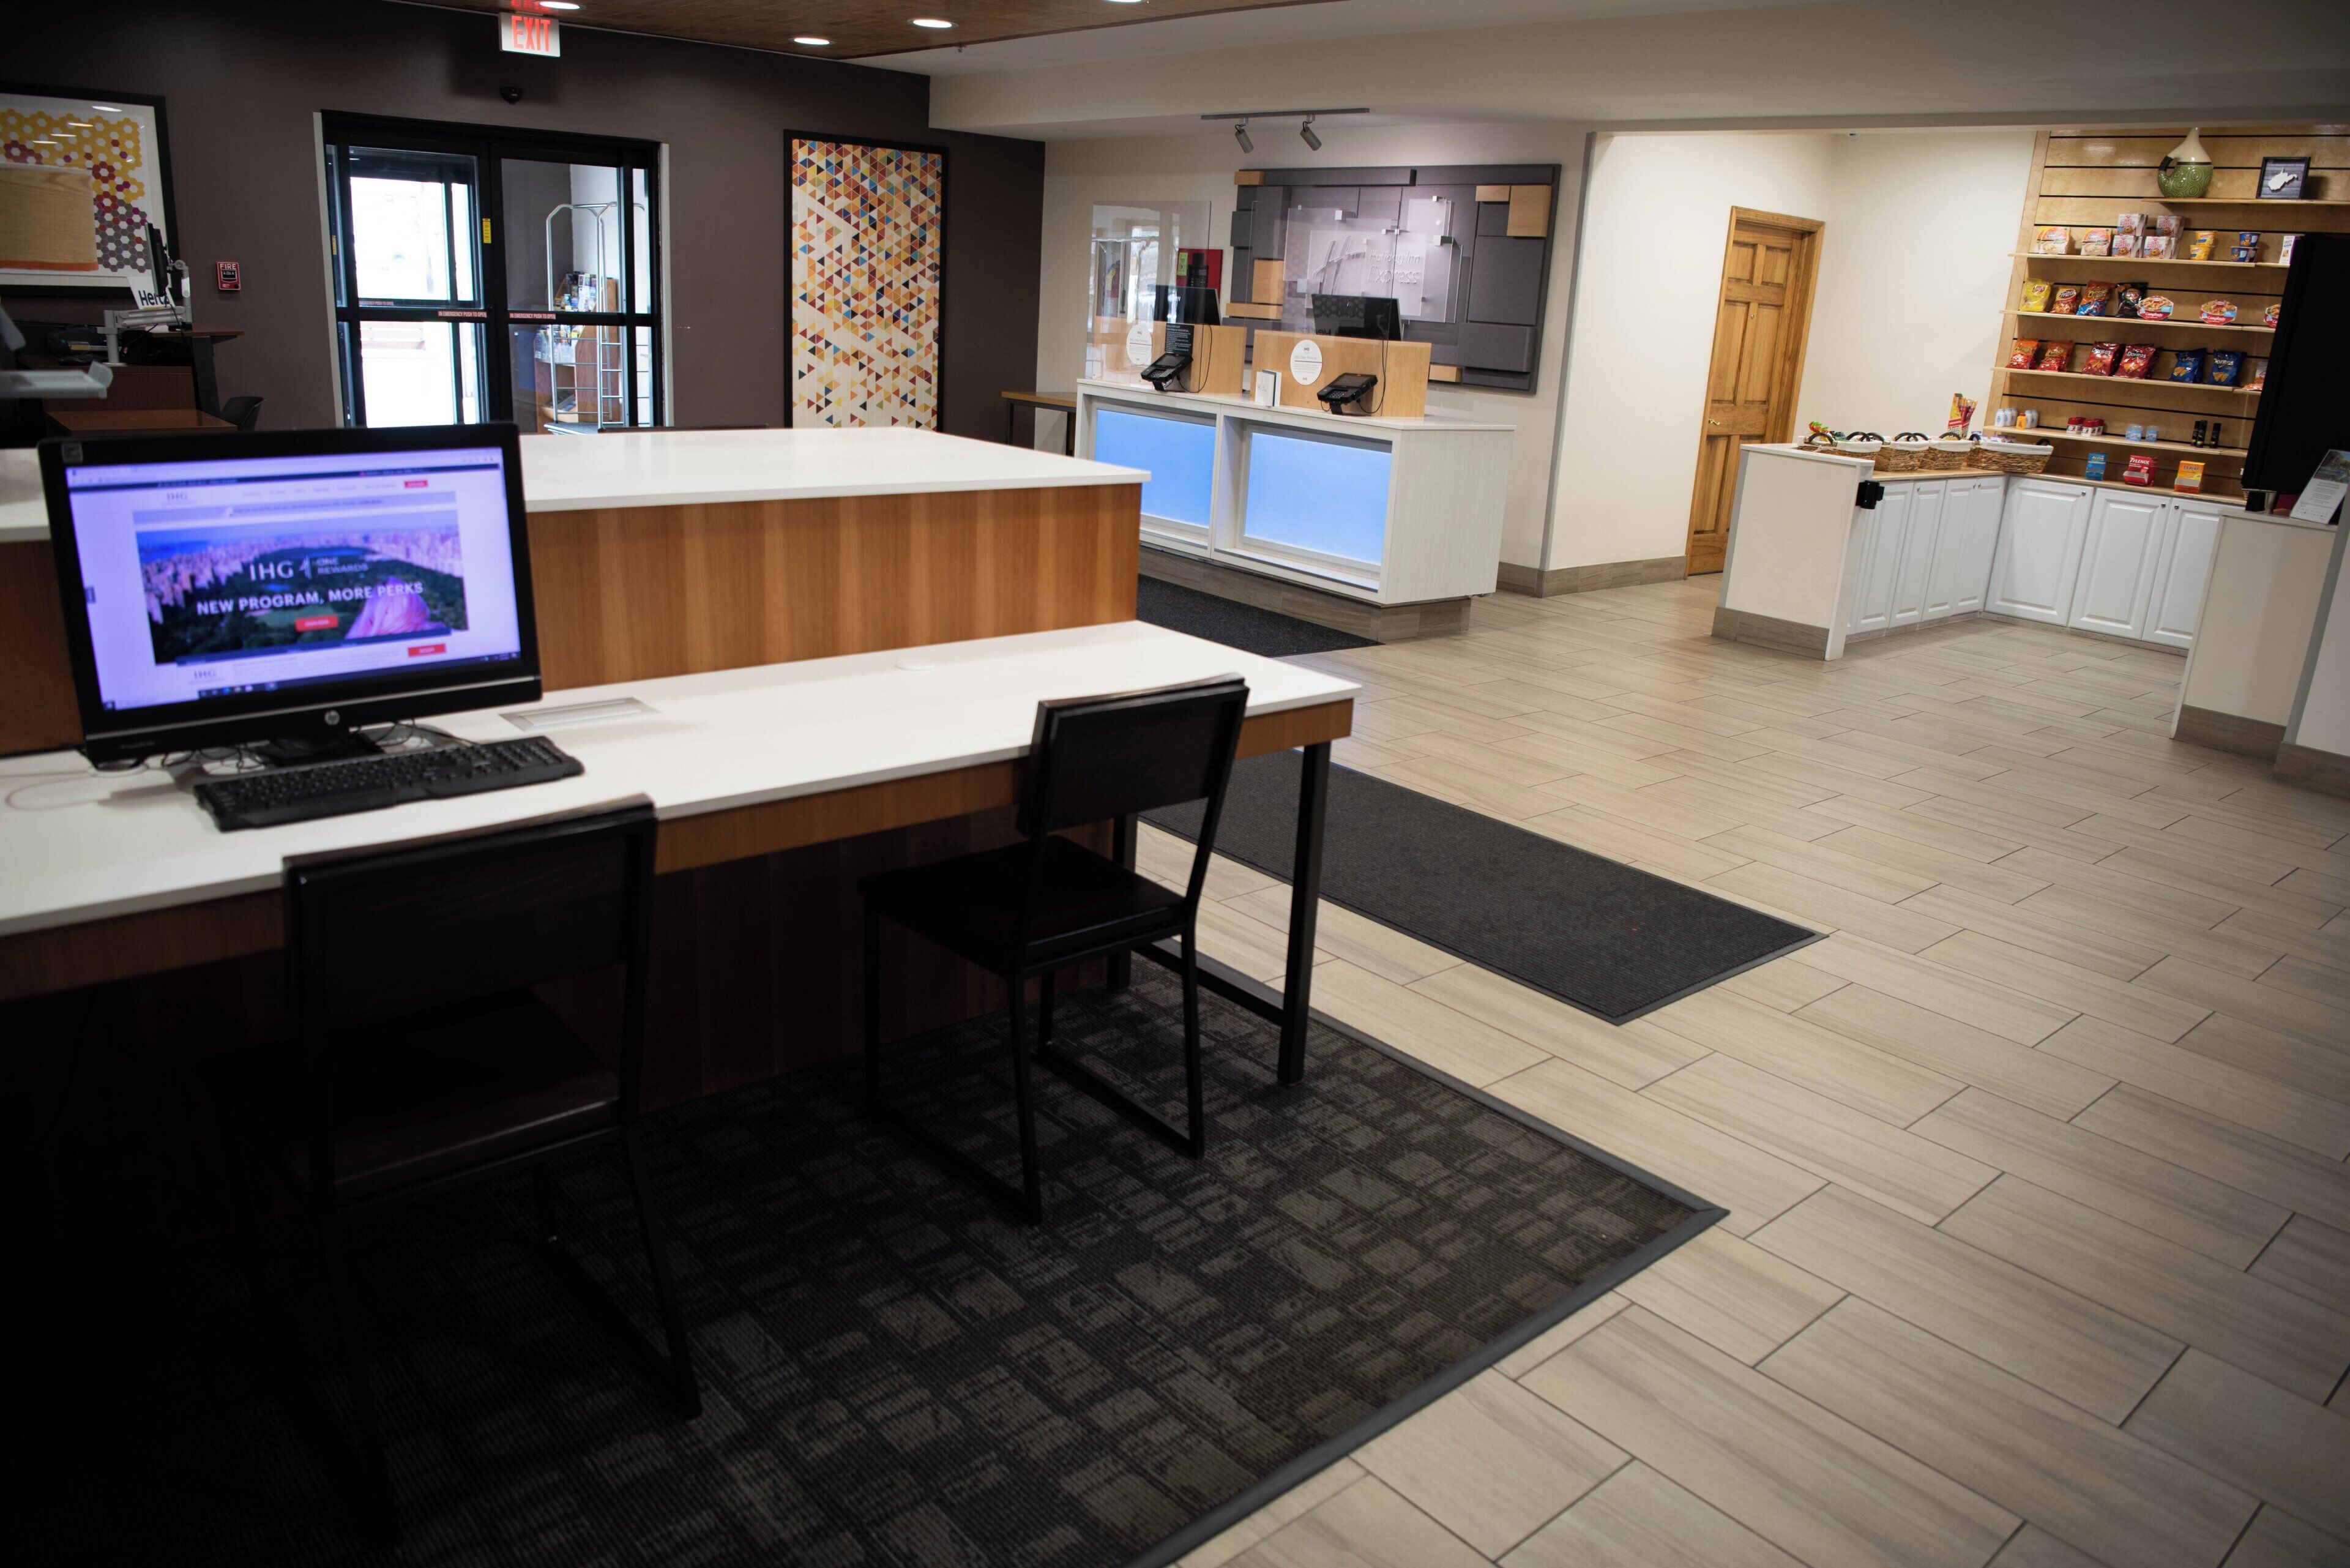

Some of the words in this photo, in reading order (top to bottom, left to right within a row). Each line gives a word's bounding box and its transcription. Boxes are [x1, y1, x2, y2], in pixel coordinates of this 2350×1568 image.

[511, 15, 551, 51] EXIT
[1369, 250, 1404, 265] Holiday
[1408, 250, 1421, 264] Inn
[1368, 266, 1421, 288] Express
[2059, 289, 2076, 298] Fritos
[249, 560, 294, 581] IHG
[316, 557, 339, 566] ONE
[317, 563, 368, 576] REWARDS
[196, 599, 234, 616] NEW
[238, 591, 324, 612] PROGRAM,
[327, 586, 374, 602] MORE
[376, 581, 423, 597] PERKS
